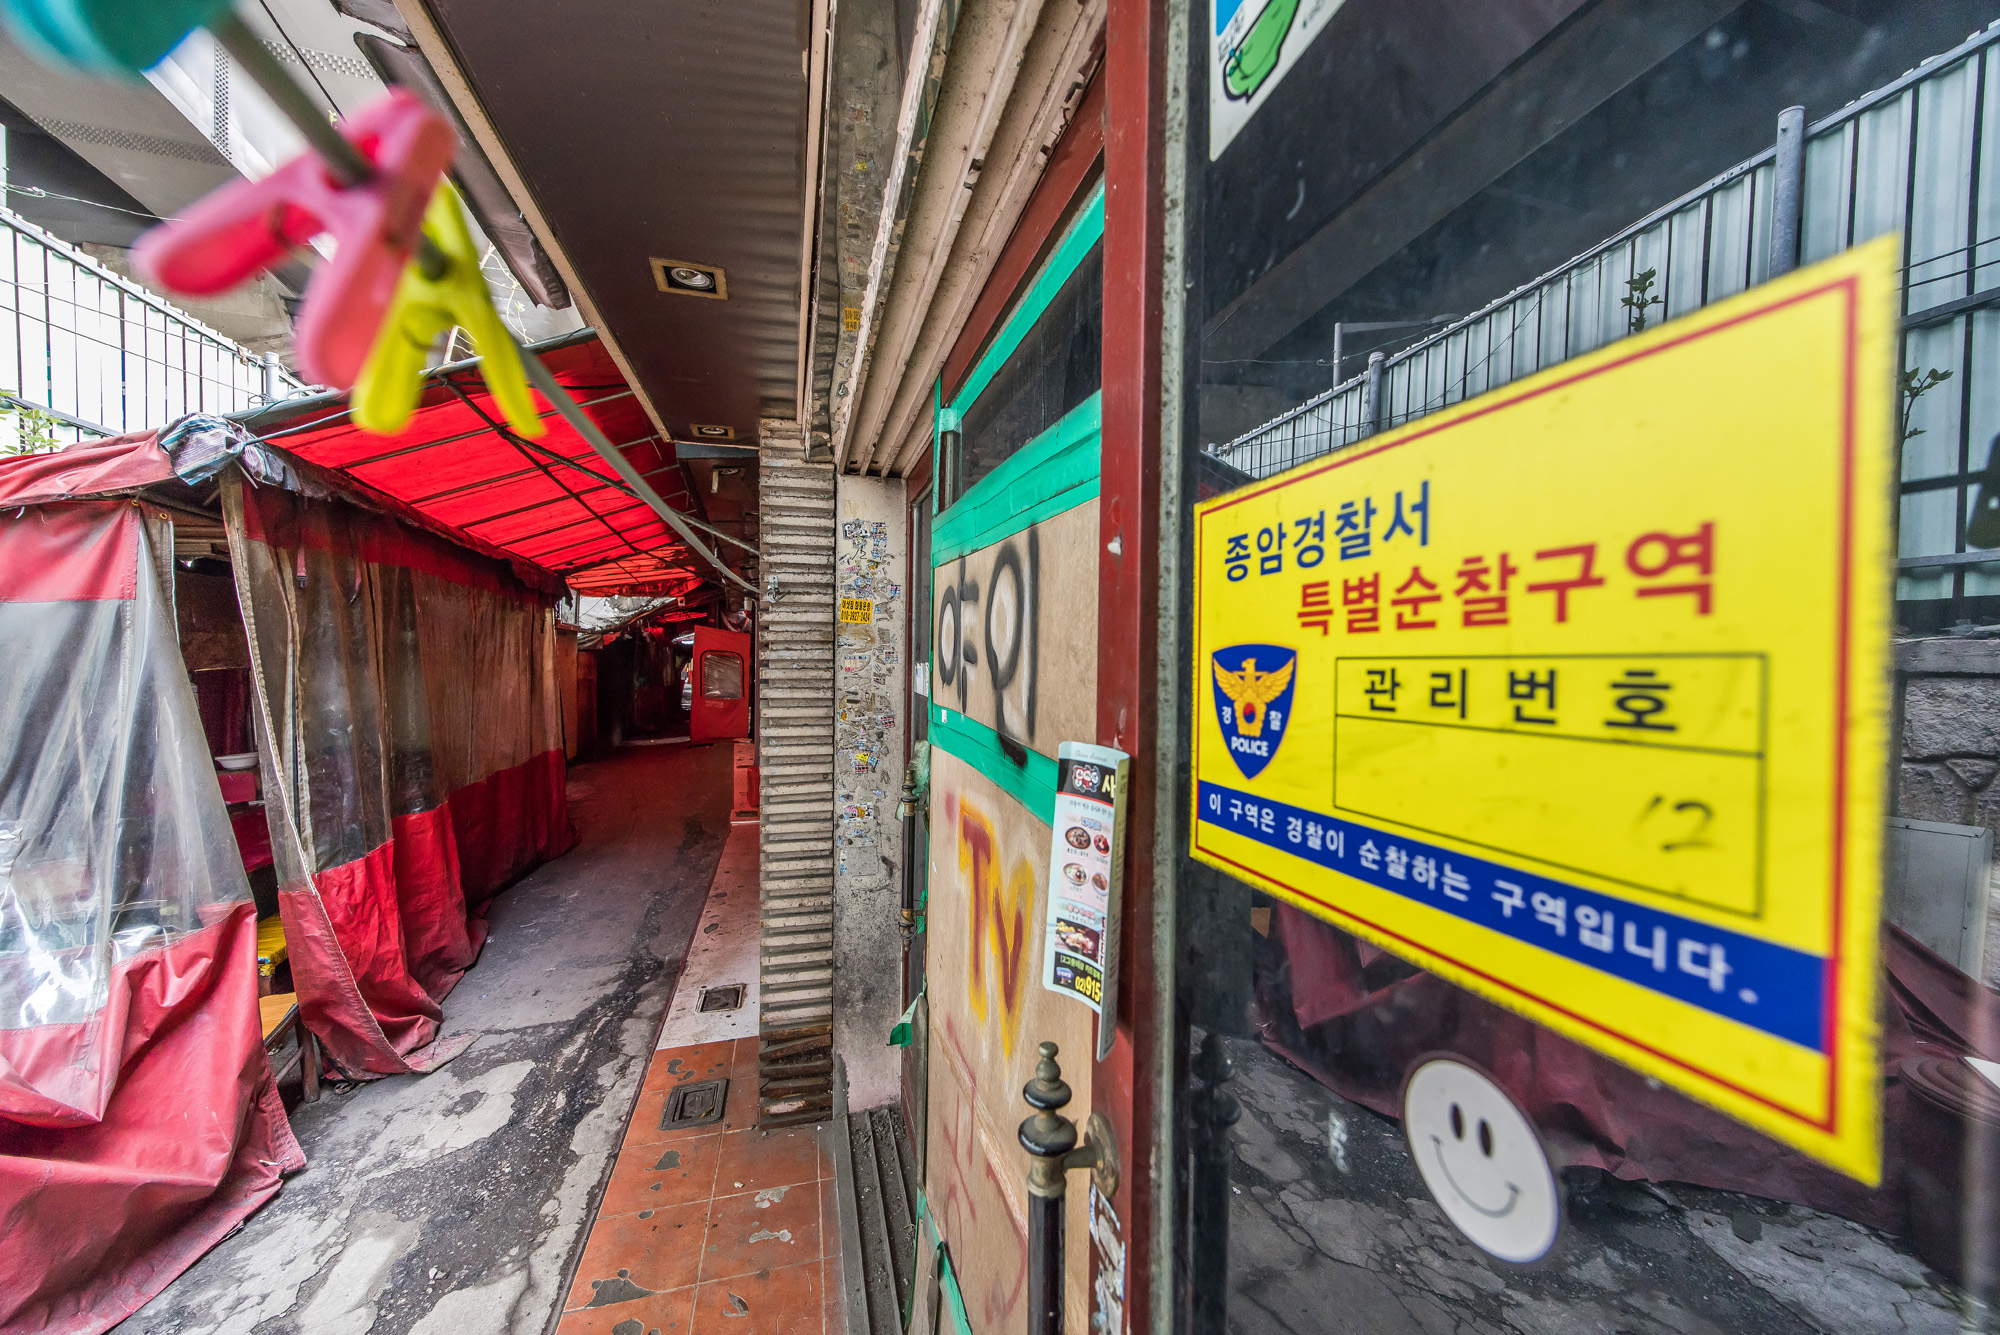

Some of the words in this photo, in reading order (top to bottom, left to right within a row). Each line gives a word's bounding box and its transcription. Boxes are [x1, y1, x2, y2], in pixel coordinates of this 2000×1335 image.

[1224, 479, 1431, 583] 종암경찰서
[1296, 520, 1717, 636] 특별순찰구역
[1230, 735, 1269, 757] POLICE
[1209, 793, 1222, 815] 이
[1229, 798, 1276, 834] 구역은
[1286, 816, 1345, 859] 경찰이
[1358, 838, 1471, 902] 순찰하는
[1490, 879, 1759, 1005] 구역입니다.
